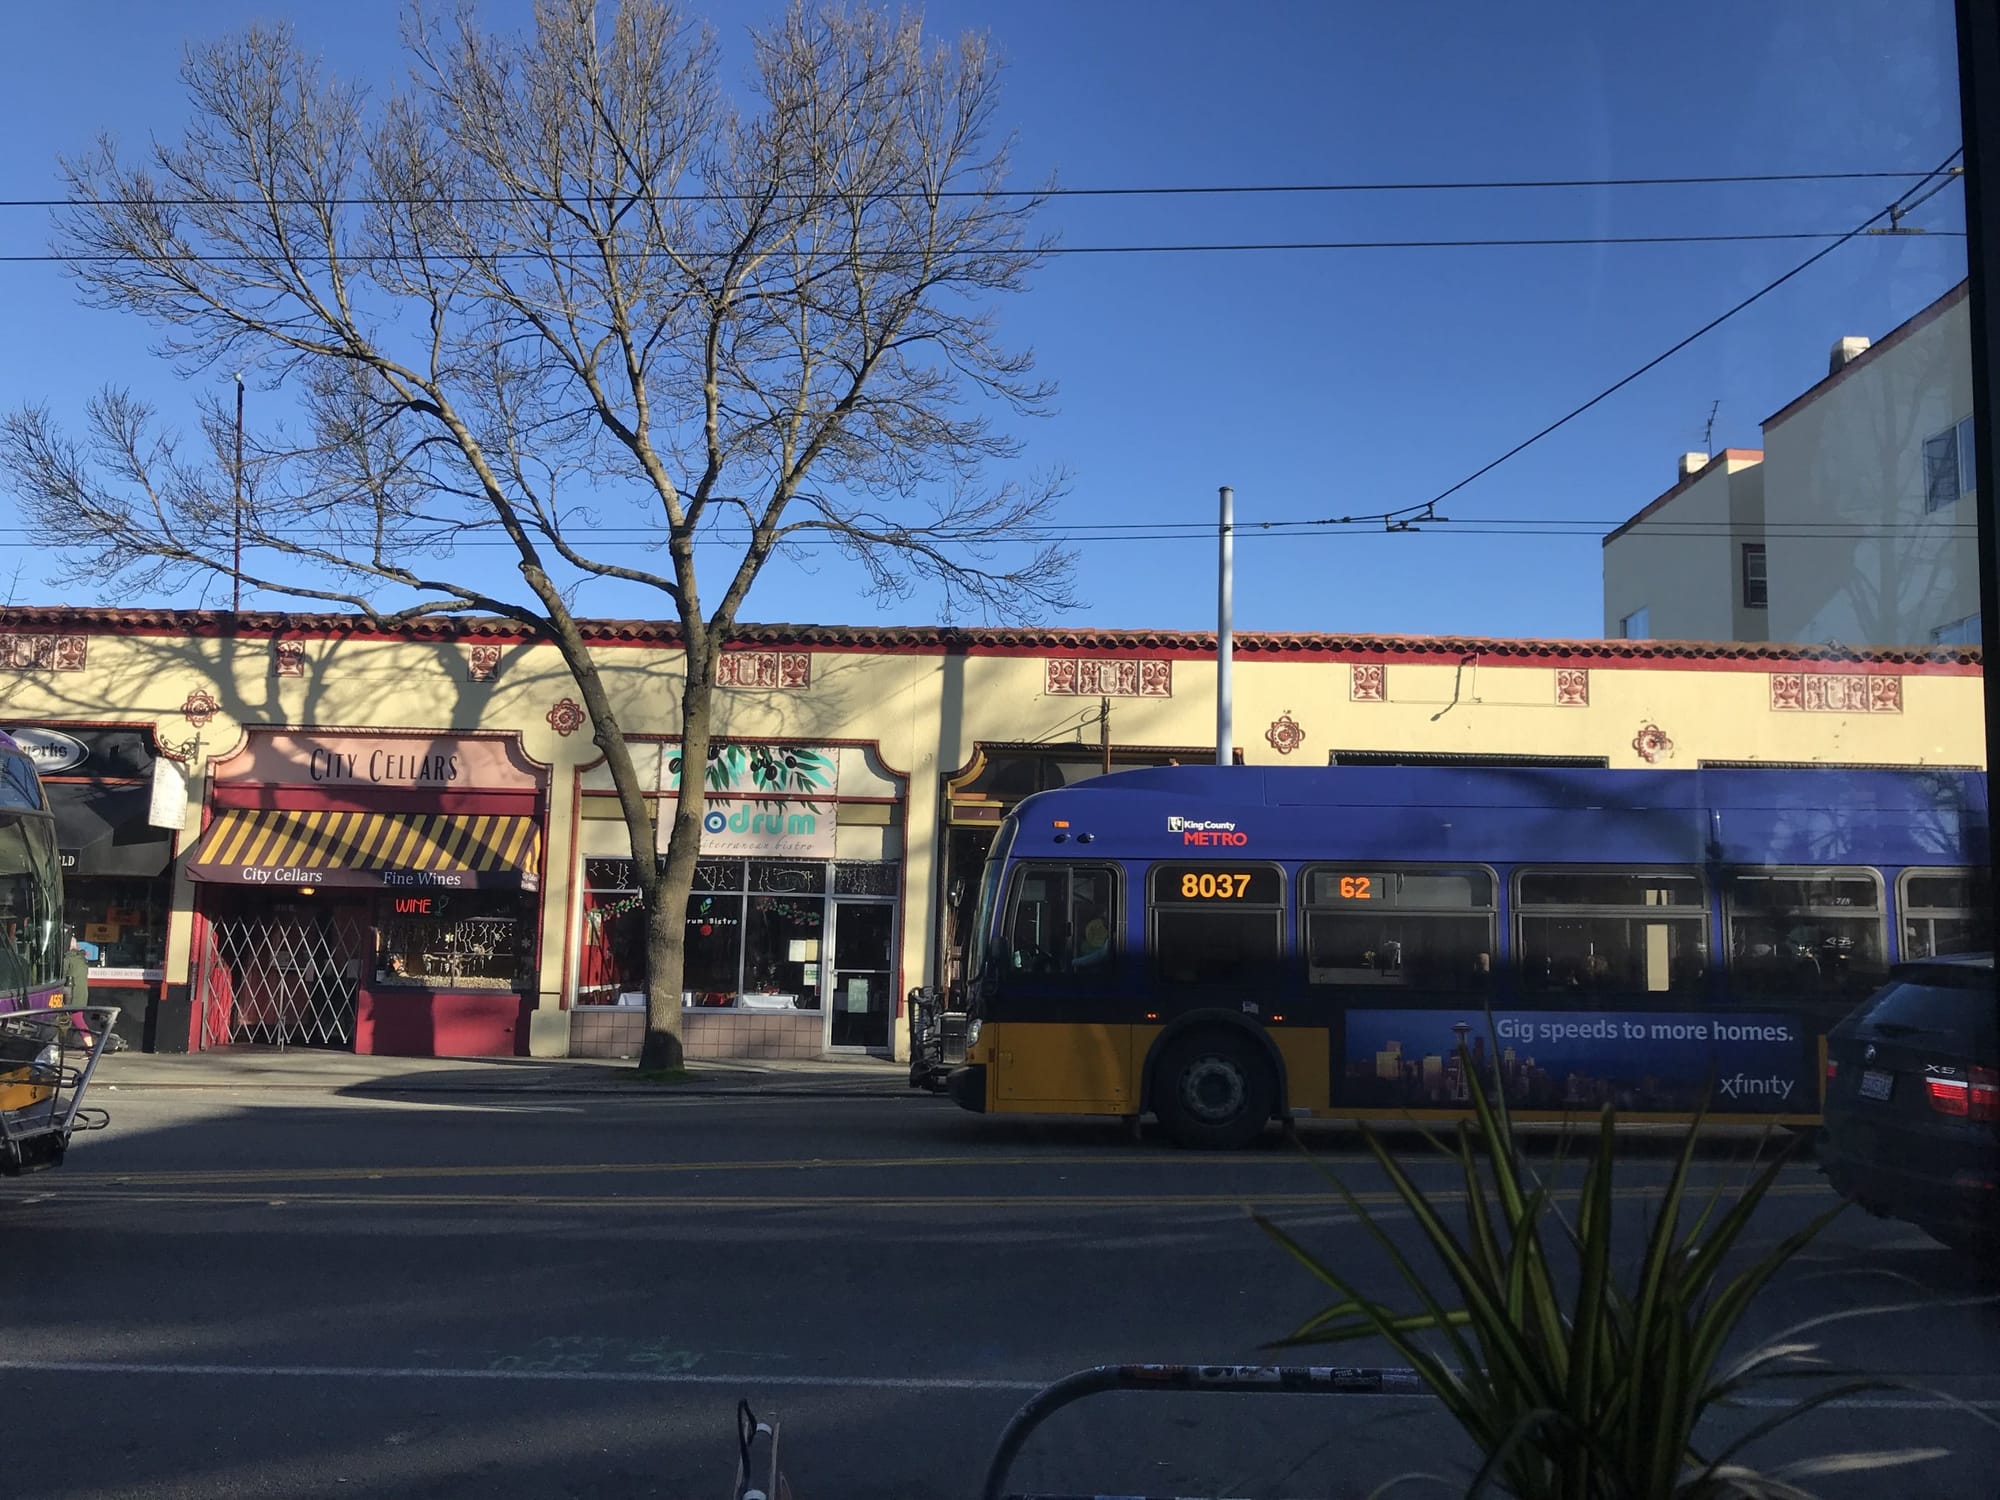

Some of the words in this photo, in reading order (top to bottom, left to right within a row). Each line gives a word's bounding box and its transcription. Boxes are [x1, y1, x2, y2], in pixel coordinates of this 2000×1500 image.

[310, 748, 357, 781] CITY
[370, 749, 459, 781] CELLARS
[704, 804, 816, 835] odrum
[1184, 820, 1204, 831] King
[1204, 820, 1236, 831] County
[1184, 832, 1248, 846] METRO
[242, 868, 271, 884] City
[274, 868, 323, 883] Cellars
[383, 872, 416, 885] Fine
[419, 872, 461, 886] Wines
[1181, 873, 1253, 899] 8037
[1339, 876, 1371, 899] 62
[395, 898, 432, 915] WINE
[1497, 1017, 1534, 1043] Gig
[1539, 1017, 1618, 1043] speeds
[1623, 1021, 1646, 1041] to
[1651, 1023, 1708, 1041] more
[1713, 1019, 1795, 1042] homes.
[1924, 1063, 1957, 1075] X5
[1720, 1072, 1796, 1101] xfinity
